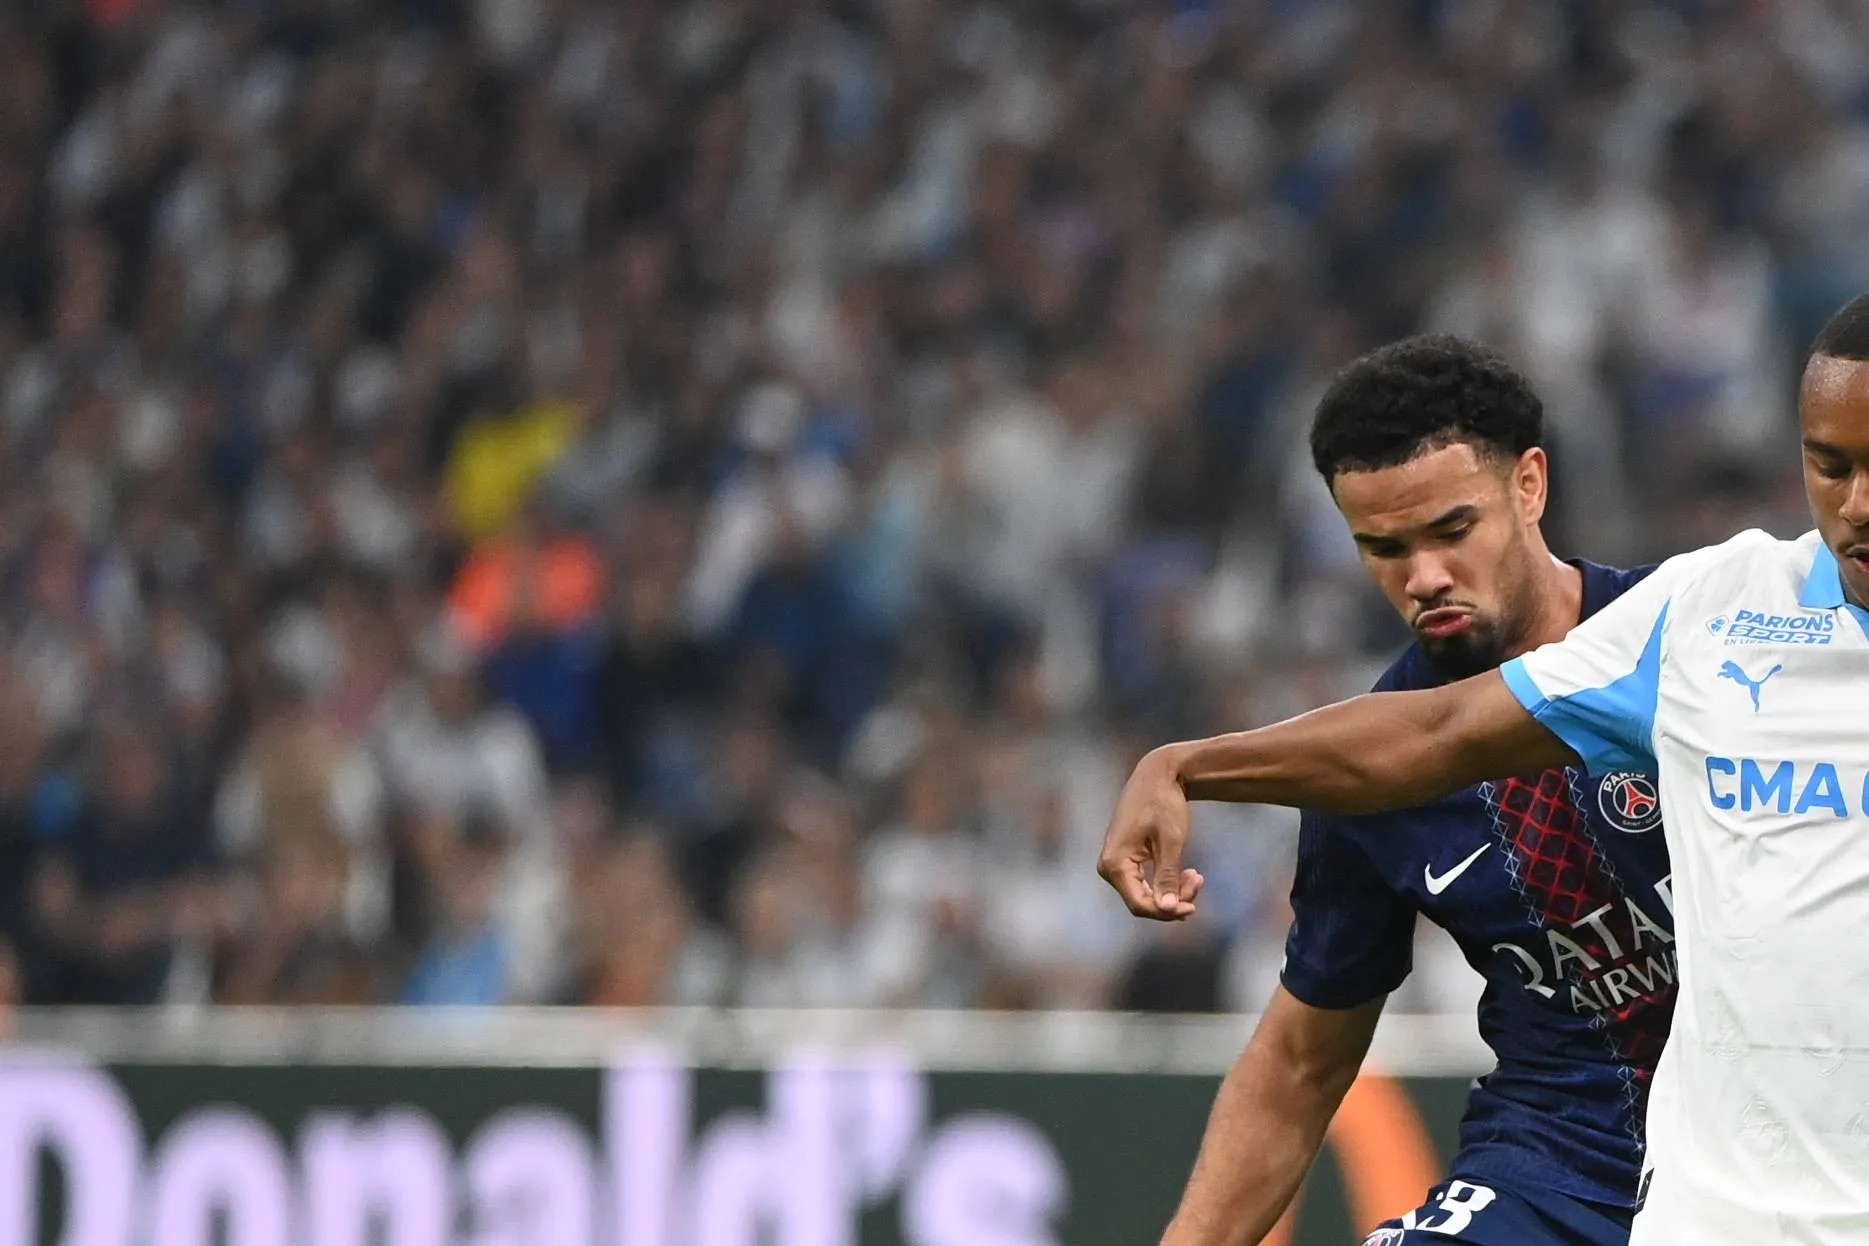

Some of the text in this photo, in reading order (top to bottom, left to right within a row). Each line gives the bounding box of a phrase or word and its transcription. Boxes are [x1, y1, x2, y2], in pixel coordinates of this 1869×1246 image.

[1735, 609, 1834, 632] PARIONS
[1704, 755, 1848, 818] CMA
[1570, 949, 1680, 1014] AIRW
[1402, 1180, 1497, 1235] 3
